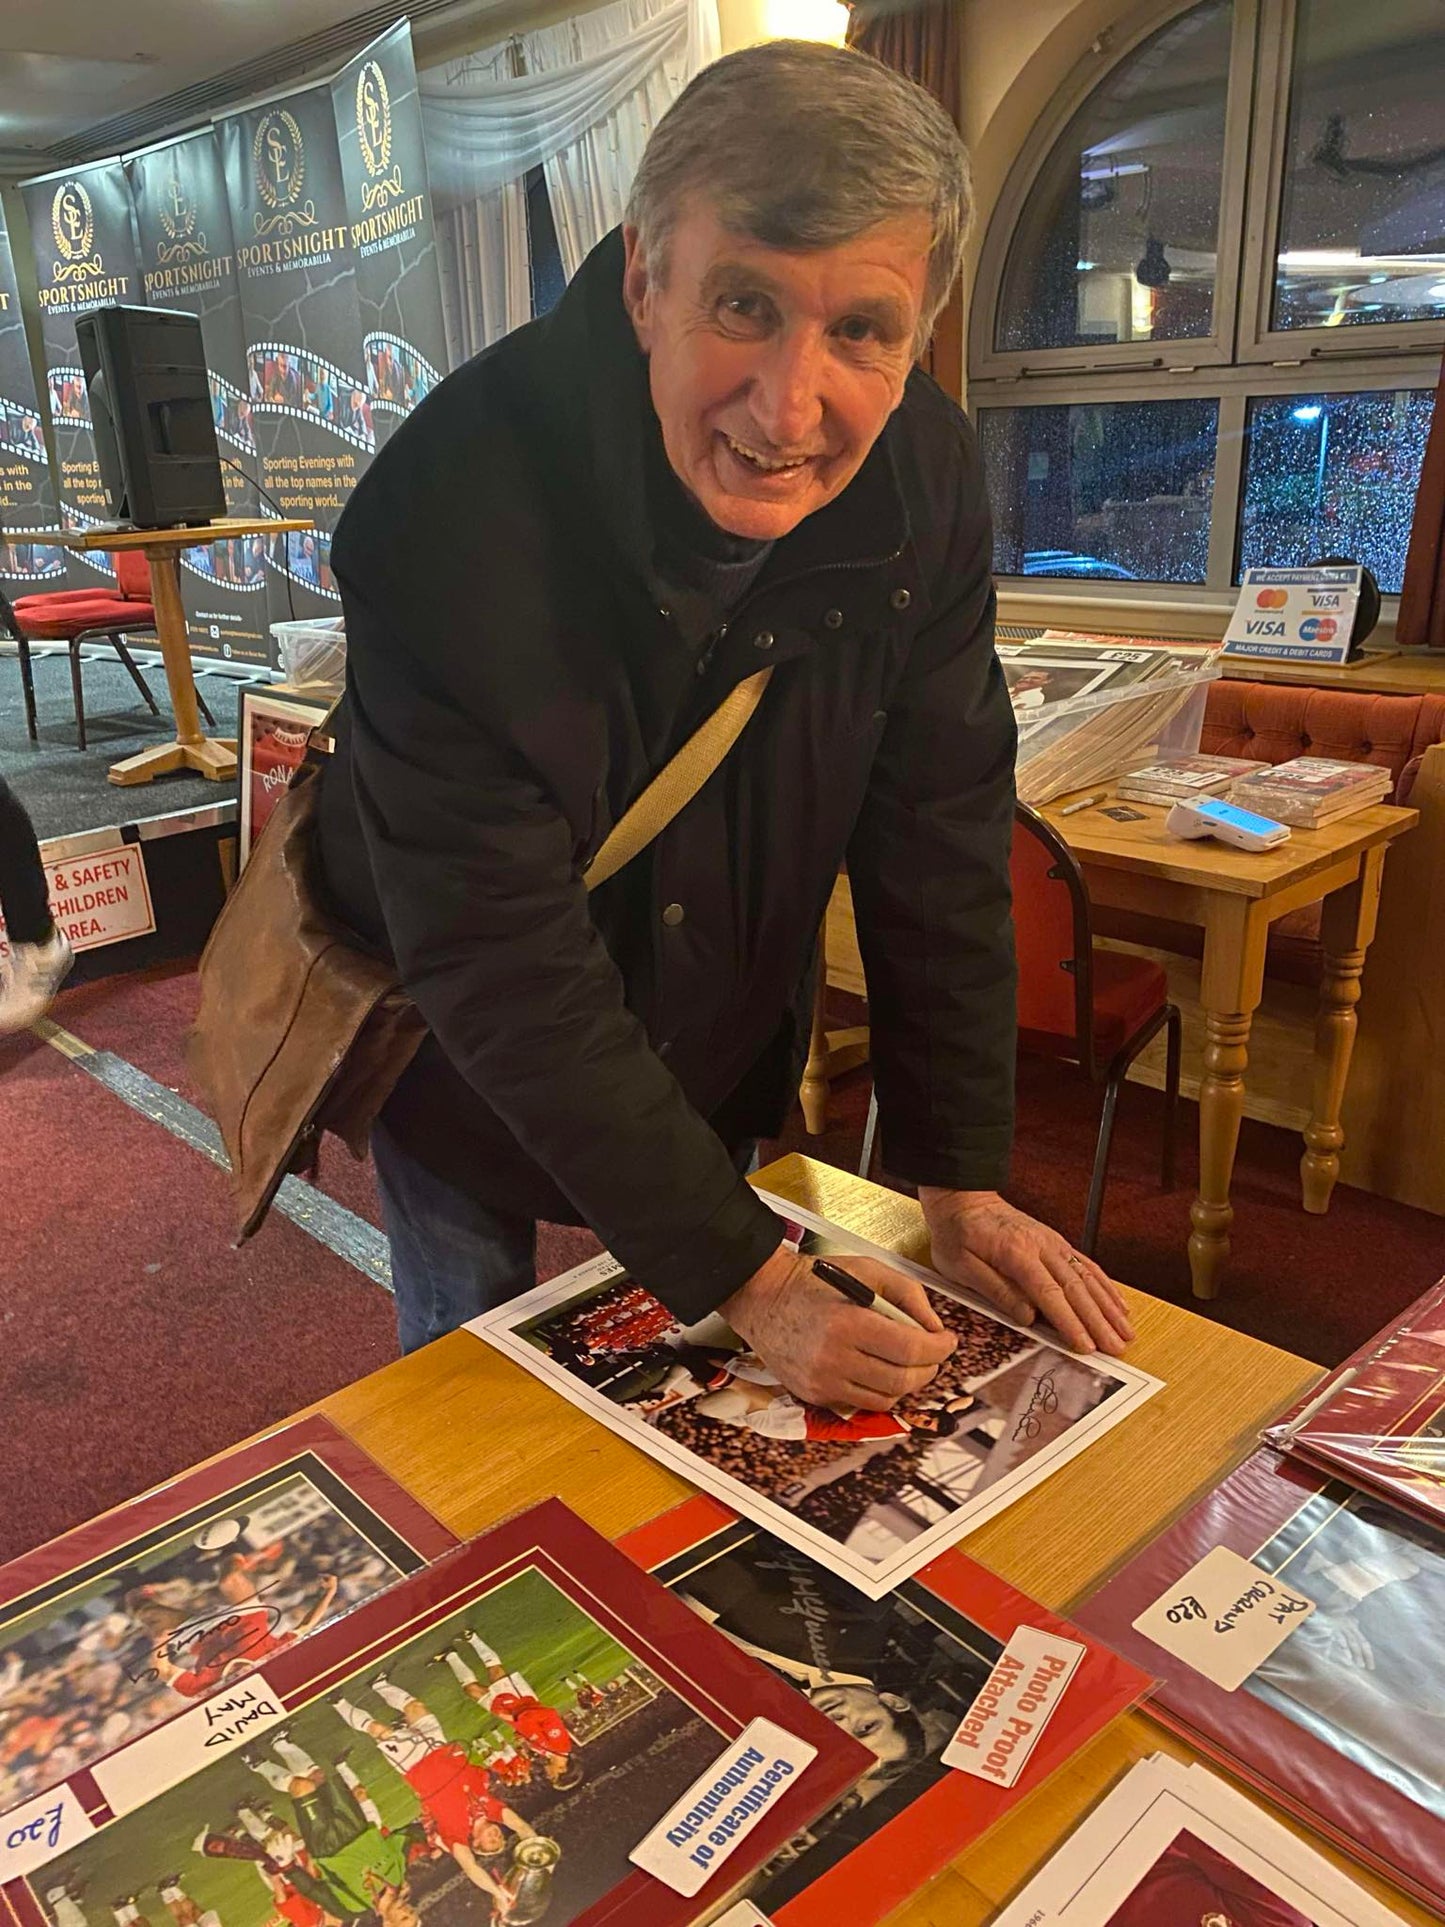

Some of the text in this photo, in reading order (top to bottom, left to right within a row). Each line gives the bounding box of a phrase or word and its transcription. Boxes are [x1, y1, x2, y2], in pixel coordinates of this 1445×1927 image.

[351, 195, 424, 248] SPORTSNIGHT
[237, 226, 348, 269] SPORTSNIGHT
[144, 256, 232, 292] SPORTSNIGHT
[247, 264, 275, 278] EVENTS
[282, 254, 332, 271] MEMORABILIA
[38, 276, 129, 307] SPORTSNIGHT
[47, 303, 70, 315] EVENTS
[6, 464, 29, 476] with
[61, 461, 92, 475] Sporting
[262, 454, 354, 472] Sporting Evenings with
[3, 480, 13, 491] in
[15, 480, 32, 491] the
[73, 478, 85, 488] the
[86, 479, 98, 490] top
[264, 475, 357, 490] all the top names in the
[77, 493, 105, 506] sporting
[279, 495, 314, 510] sporting
[1267, 573, 1291, 582] ACCEPT
[1311, 595, 1340, 607] VISA
[1246, 619, 1286, 636] VISA
[1108, 651, 1144, 661] £25
[1235, 645, 1258, 653] MAJOR
[1259, 646, 1283, 654] CREDIT
[1289, 647, 1309, 657] DEBIT
[1309, 648, 1332, 658] CARDS
[54, 858, 130, 891] & SAFETY
[1267, 1593, 1309, 1625] PAT
[204, 1690, 257, 1727] MAY
[954, 1653, 1026, 1750] Attached
[204, 1700, 279, 1748] DAVID
[980, 1654, 1068, 1780] Photo Proof
[665, 1746, 766, 1848] Authenticity
[689, 1758, 795, 1871] Certificate of
[6, 1802, 64, 1849] £20
